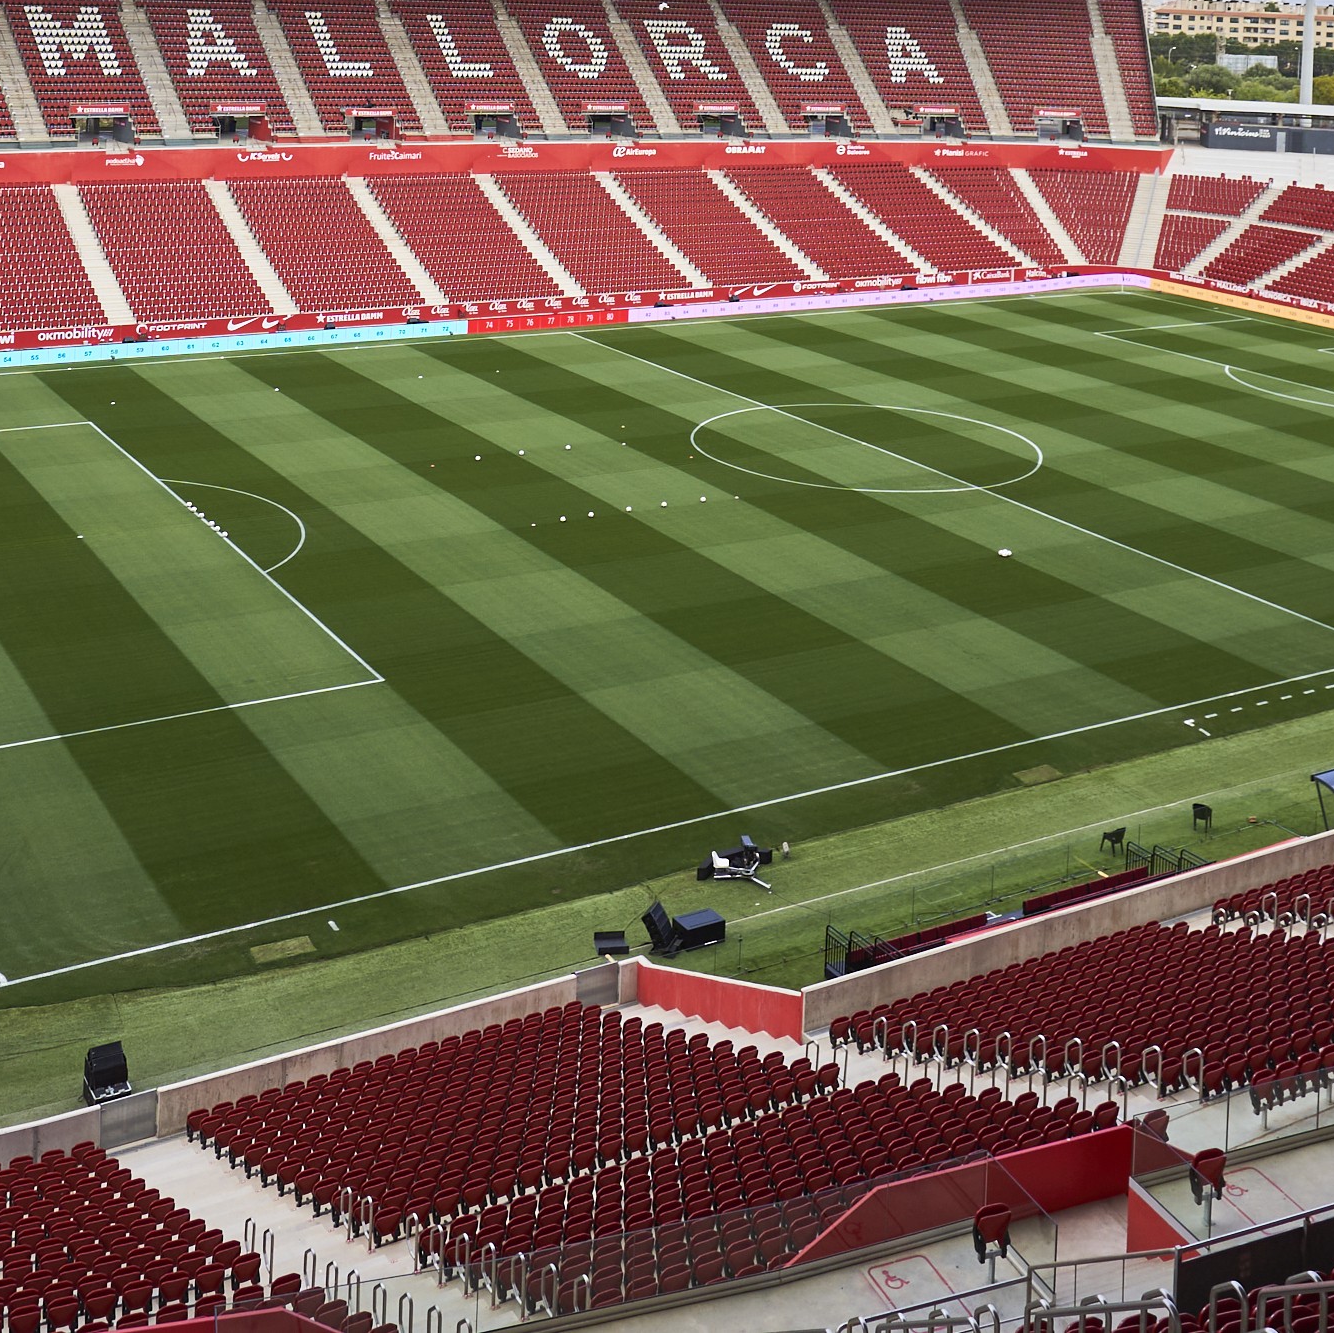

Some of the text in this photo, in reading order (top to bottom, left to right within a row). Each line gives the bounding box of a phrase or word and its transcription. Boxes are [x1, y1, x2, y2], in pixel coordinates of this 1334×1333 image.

[625, 147, 657, 156] AirEuropa
[725, 146, 766, 154] OBRAMAT
[667, 291, 694, 300] ESTRELLA
[1259, 289, 1291, 303] MENORCA
[326, 312, 383, 323] ESTRELLA DAMM
[149, 322, 207, 332] FOOTPRINT
